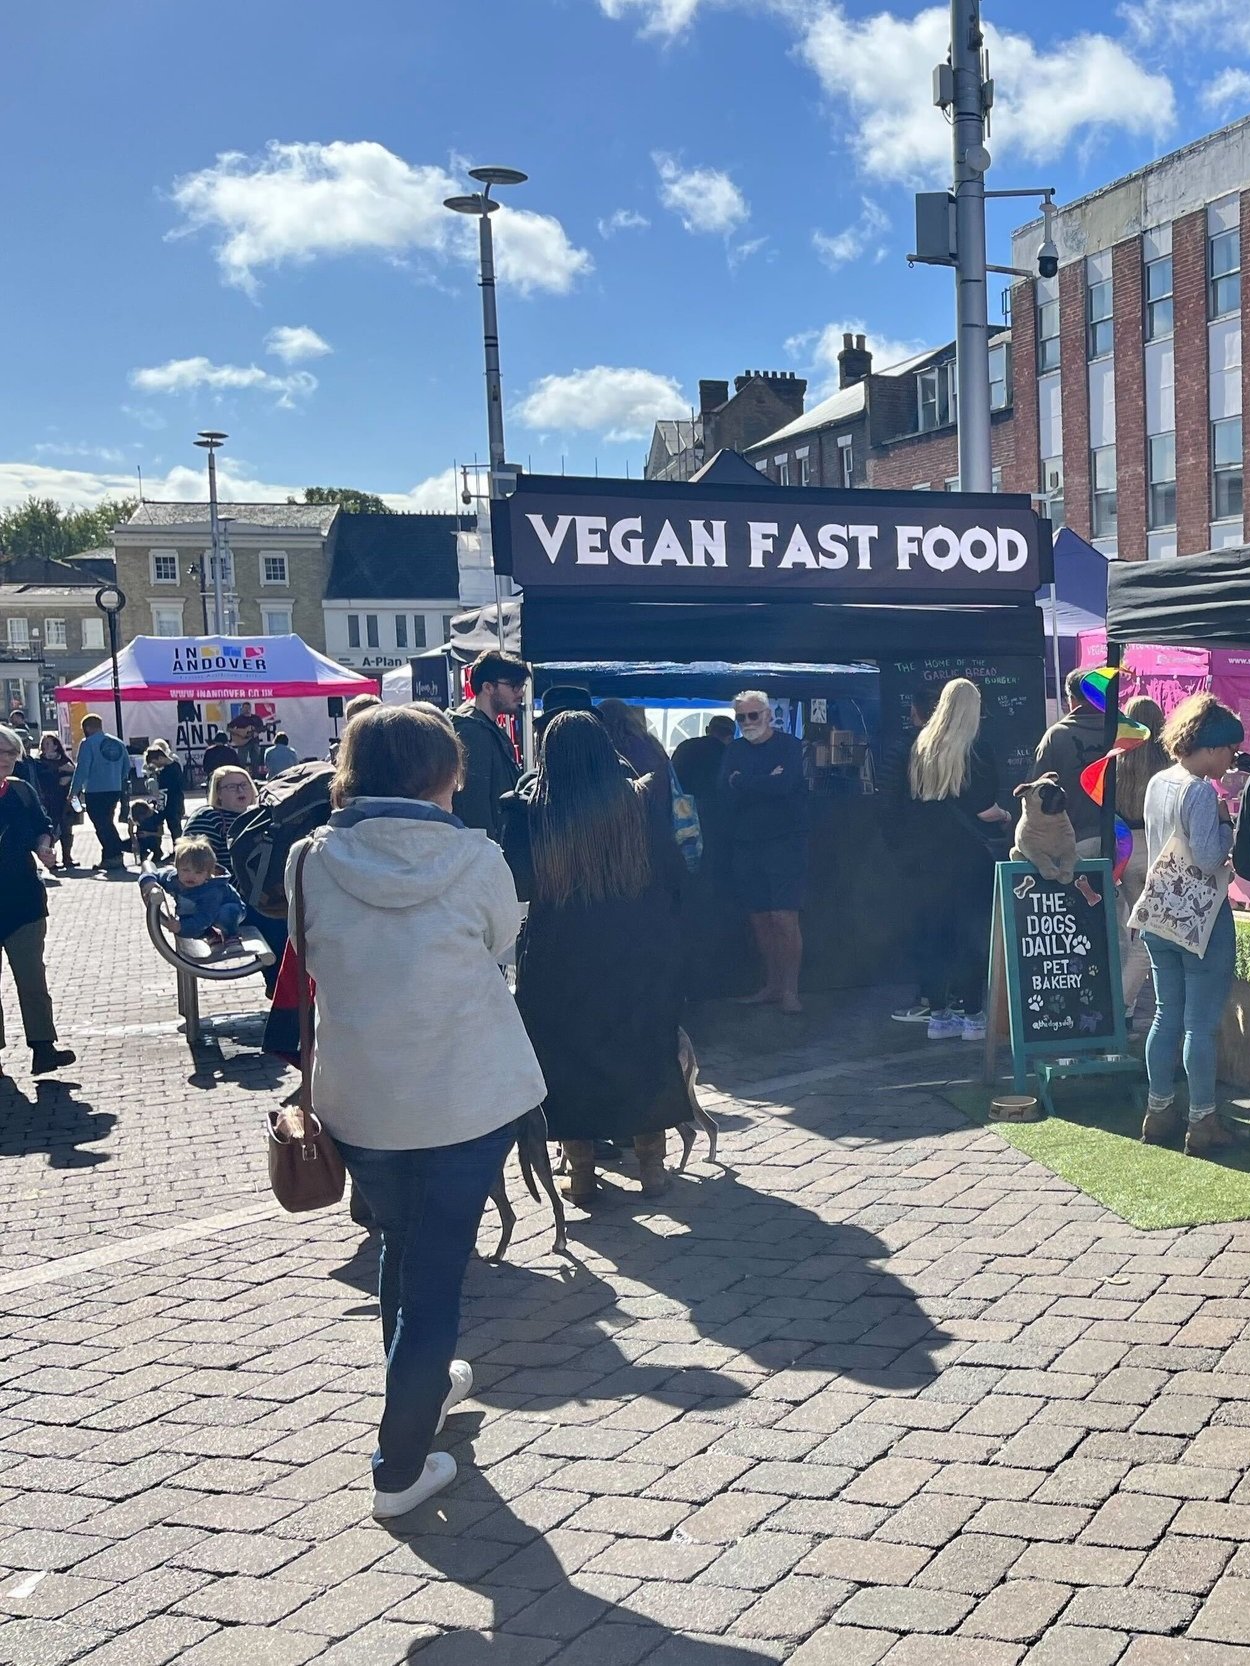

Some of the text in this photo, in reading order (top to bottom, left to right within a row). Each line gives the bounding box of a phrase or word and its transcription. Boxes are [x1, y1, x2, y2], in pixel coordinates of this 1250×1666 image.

[525, 513, 1029, 573] VEGAN FAST FOOD
[174, 647, 197, 659] IN
[173, 656, 267, 671] ANDOVER
[362, 656, 402, 667] A-Plan
[894, 662, 916, 673] THE
[925, 659, 950, 668] HOME
[965, 667, 997, 677] BREAD
[1029, 893, 1067, 913] THE
[1027, 915, 1077, 935] DOGS
[1022, 934, 1074, 957] DAILY
[1043, 959, 1069, 974] PET
[1032, 974, 1083, 991] BAKERY
